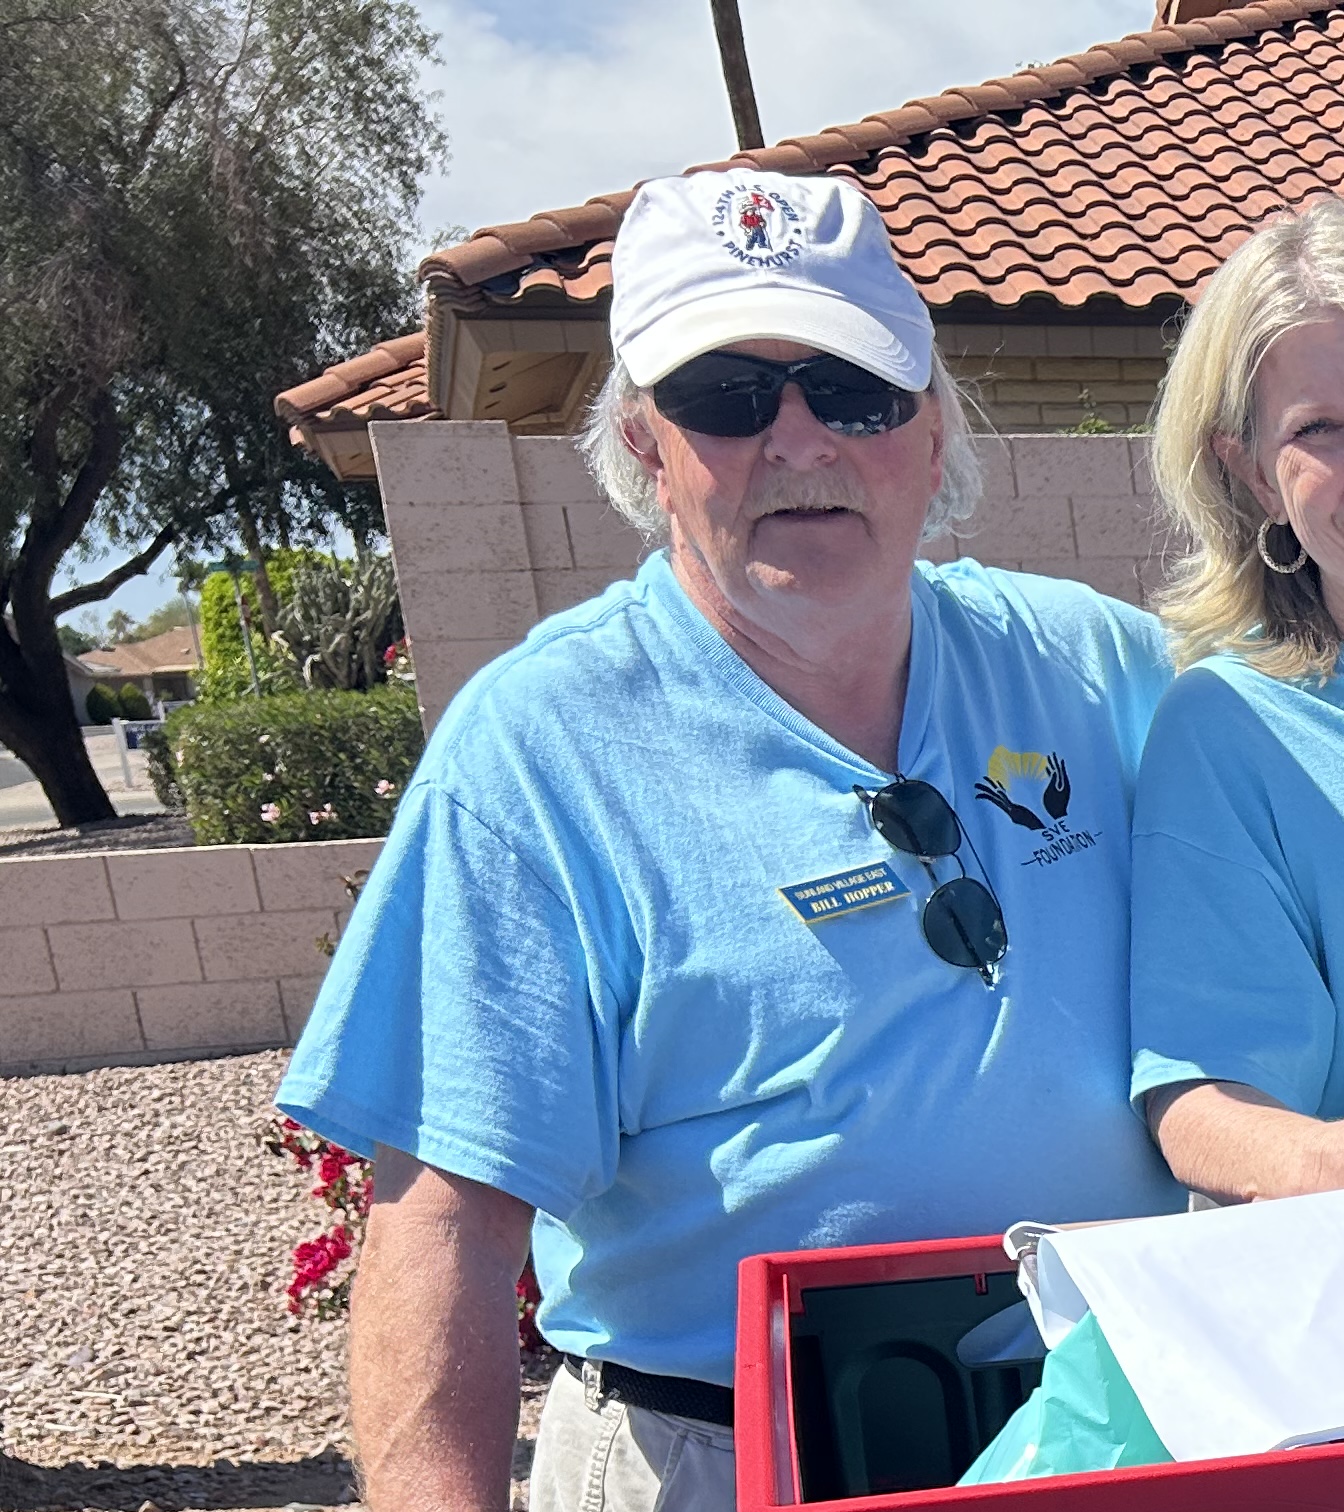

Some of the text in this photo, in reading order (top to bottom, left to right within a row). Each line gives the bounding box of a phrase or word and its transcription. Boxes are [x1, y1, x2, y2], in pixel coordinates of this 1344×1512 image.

[711, 189, 736, 227] 124TH
[768, 192, 800, 222] OPEN
[722, 238, 804, 268] PINEHURST
[1041, 820, 1071, 842] SVE
[833, 873, 868, 890] VILLAGE
[864, 867, 888, 881] EAST
[811, 880, 896, 914] BILL HOPPER
